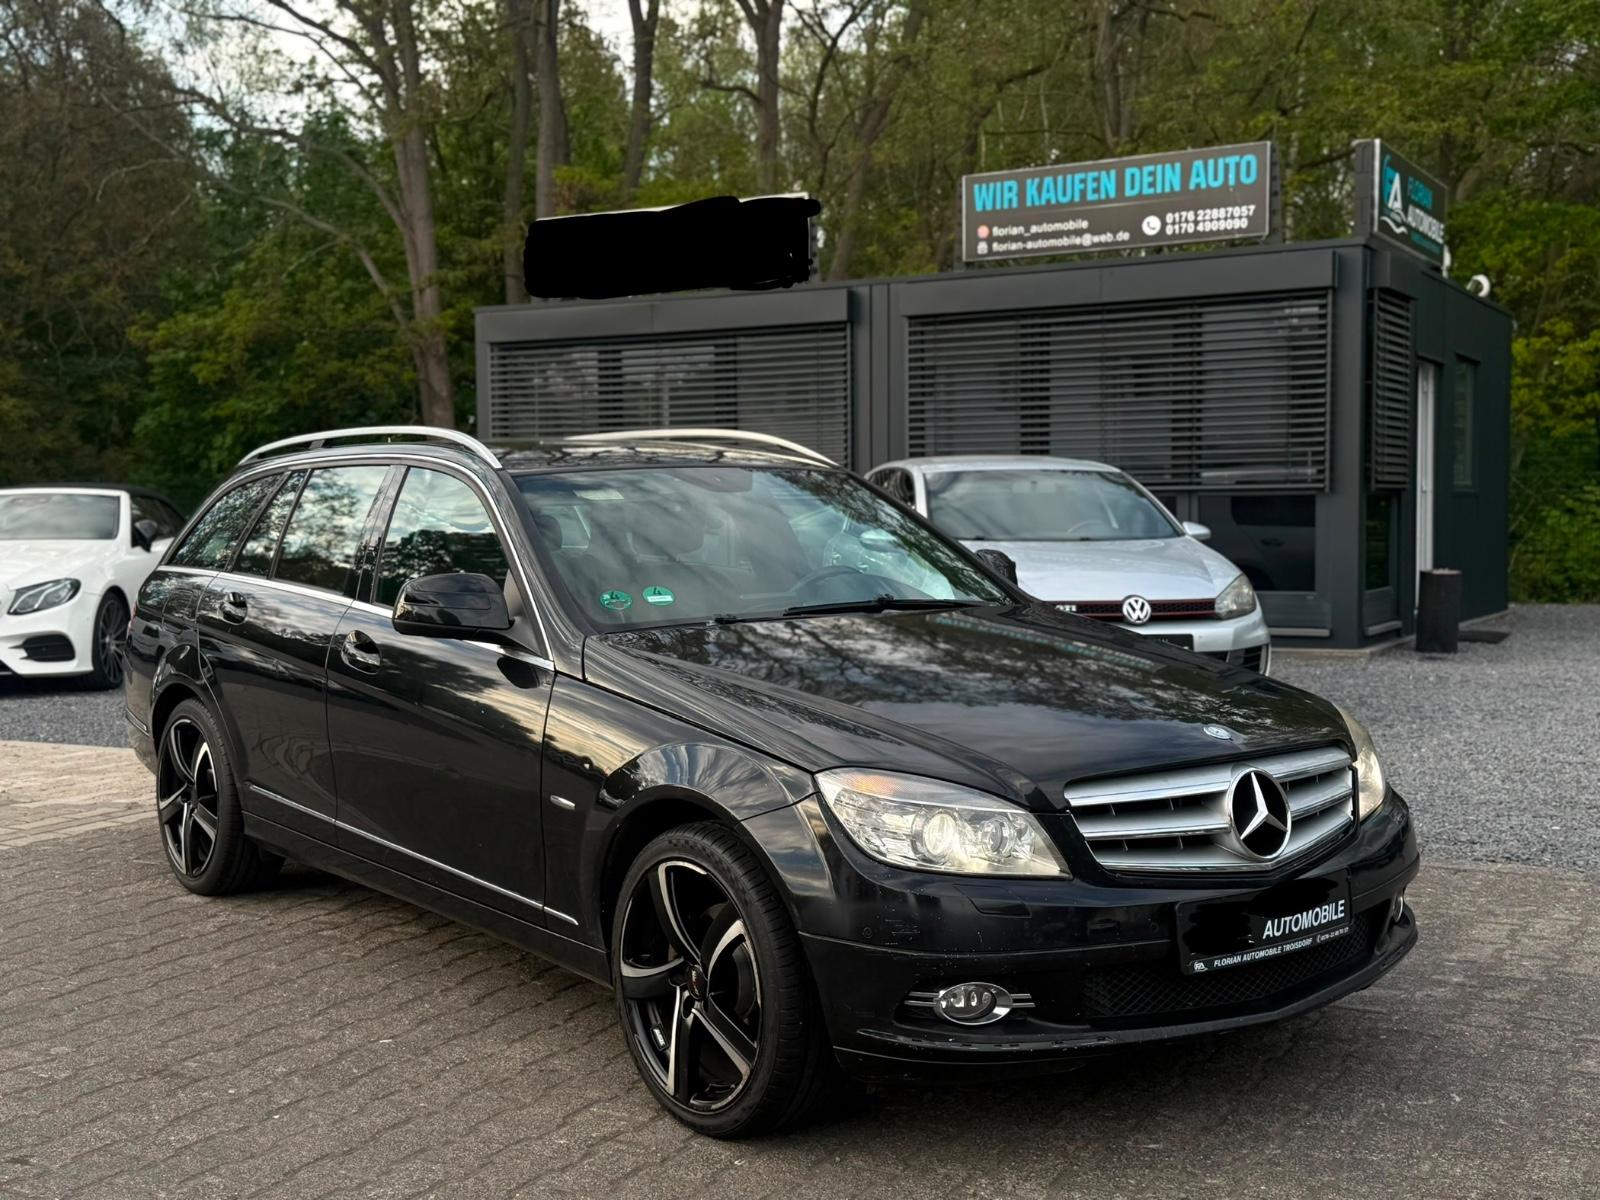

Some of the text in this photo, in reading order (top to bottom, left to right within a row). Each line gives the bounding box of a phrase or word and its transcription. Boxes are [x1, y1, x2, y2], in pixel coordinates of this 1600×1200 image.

[973, 154, 1258, 212] WIR KAUFEN DEIN AUTO
[1165, 210, 1195, 224] 0176
[1165, 222, 1195, 235] 0170
[1262, 899, 1345, 940] AUTOMOBILE
[1213, 954, 1242, 967] FLORIAN
[1242, 946, 1282, 961] AUTOMOBILE
